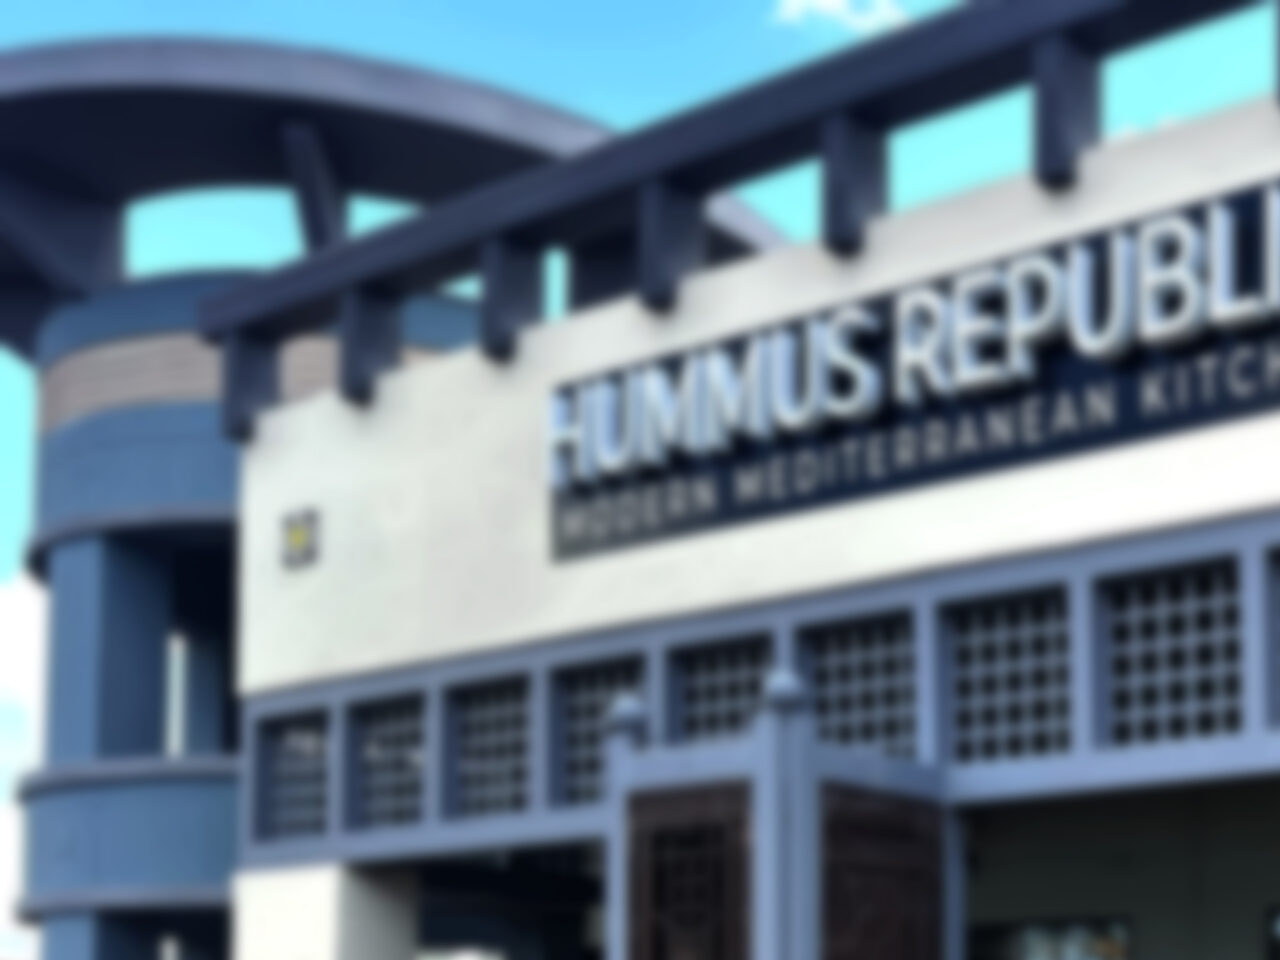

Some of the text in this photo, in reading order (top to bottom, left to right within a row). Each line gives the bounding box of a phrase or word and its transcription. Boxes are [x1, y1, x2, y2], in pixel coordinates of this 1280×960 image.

[549, 304, 882, 490] HUMMUS
[561, 477, 718, 540] MODERN
[735, 384, 1117, 499] MEDITERRANEAN
